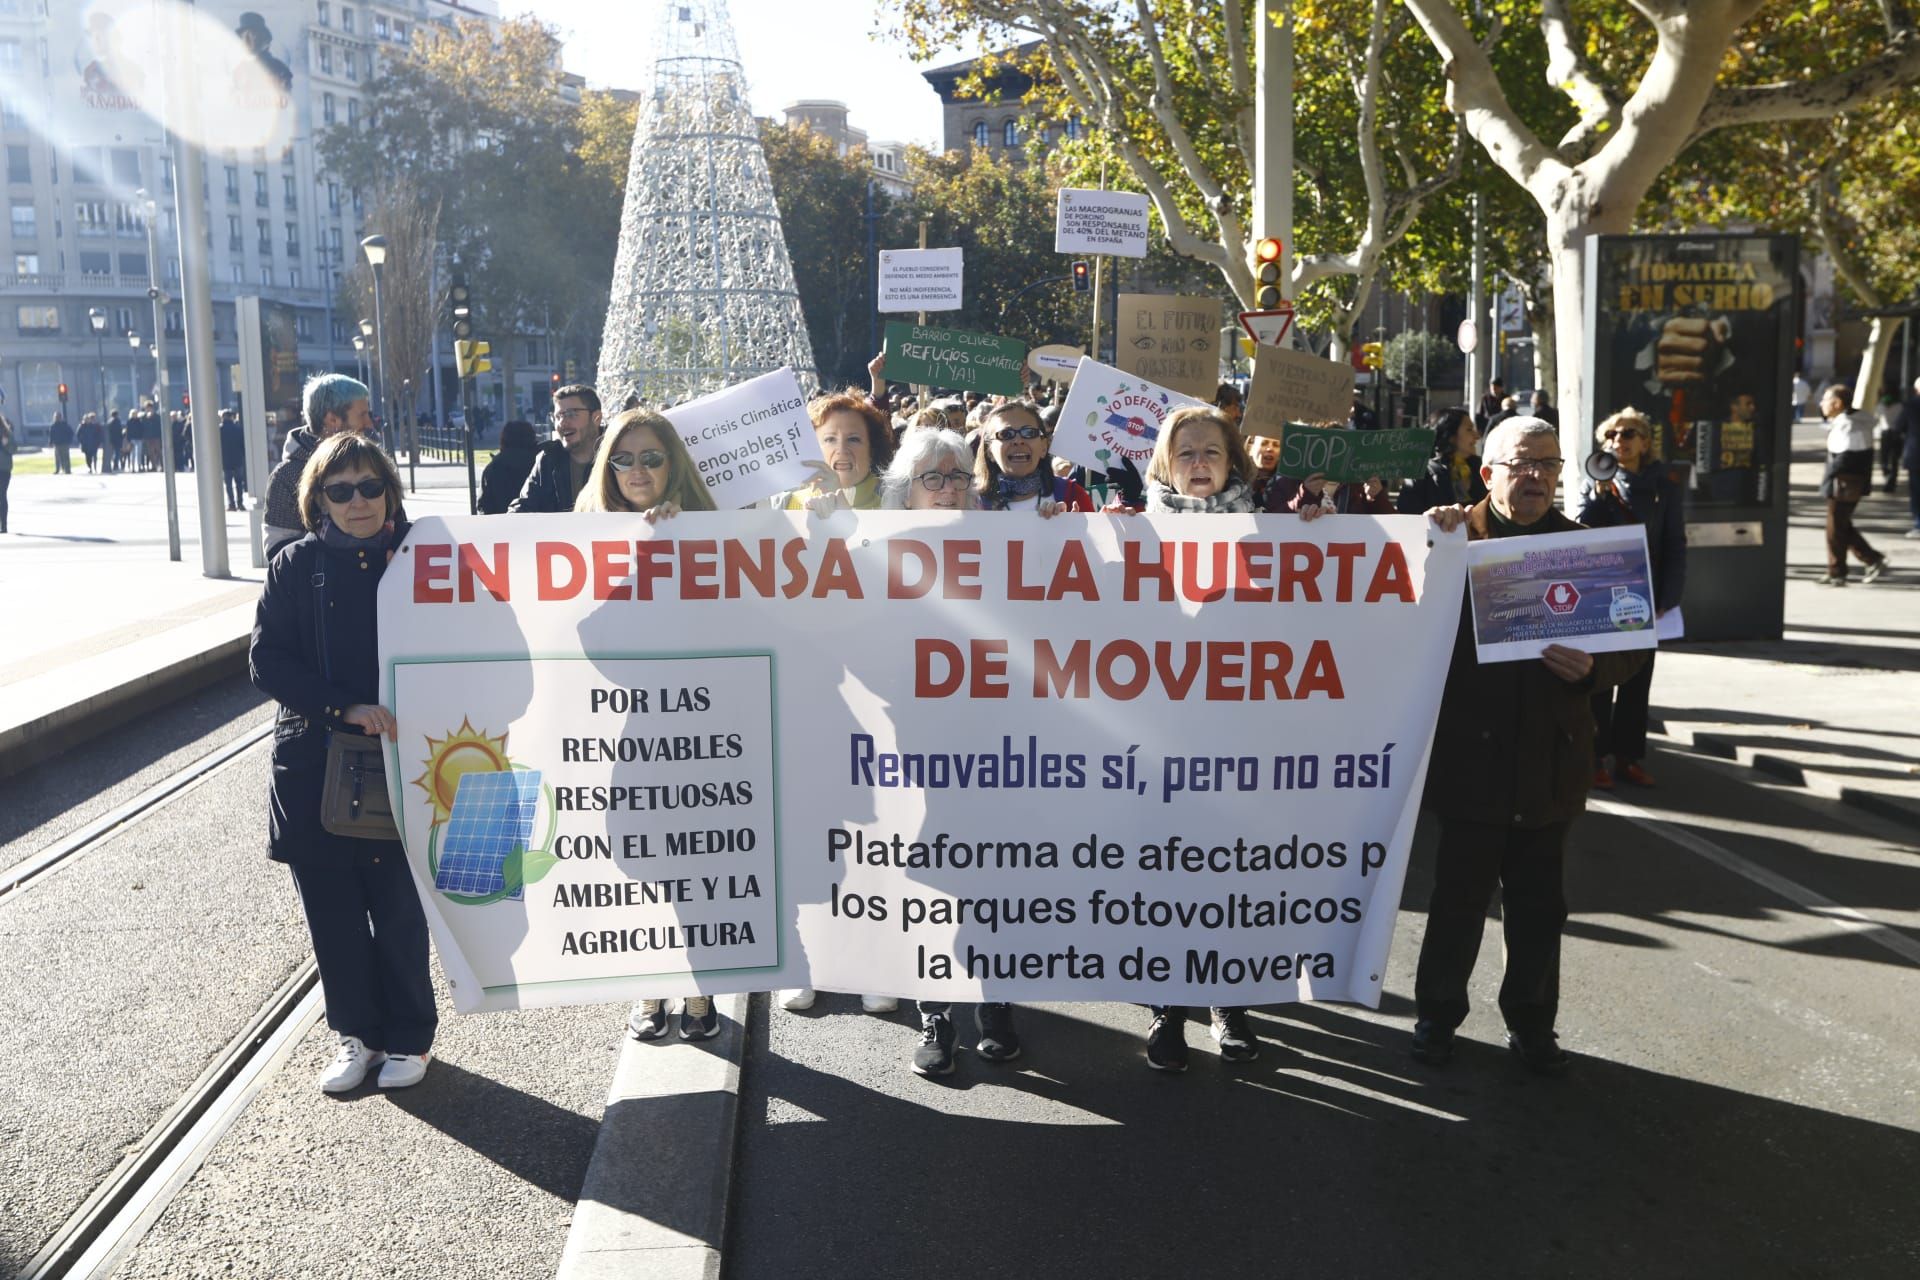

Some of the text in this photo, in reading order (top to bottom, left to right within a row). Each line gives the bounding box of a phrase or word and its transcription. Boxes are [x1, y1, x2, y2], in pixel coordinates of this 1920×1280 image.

[1079, 206, 1142, 216] MACROGRANJAS
[1082, 220, 1140, 230] RESPONSABLES
[1095, 228, 1108, 236] DEL
[1112, 229, 1145, 238] METANO
[1098, 236, 1122, 244] ESPAÑA
[1620, 283, 1774, 310] EN SERIO
[1136, 310, 1156, 330] EL
[912, 327, 1000, 349] BARRIO OLIVER
[948, 364, 976, 384] YA!!
[1105, 396, 1166, 424] YO DEFIEN
[684, 434, 698, 448] te
[702, 420, 738, 440] Crisis
[1102, 431, 1114, 445] LA
[1127, 421, 1144, 432] STOP
[698, 422, 800, 473] enovables sí
[706, 441, 800, 487] ero no así !
[414, 538, 1417, 604] EN DEFENSA DE LA HUERTA
[1553, 604, 1573, 612] STOP
[914, 638, 1345, 701] DE MOVERA
[590, 686, 711, 714] POR LAS
[562, 734, 743, 762] RENOVABLES
[850, 732, 1397, 803] Renovables sí, pero no así
[555, 780, 753, 811] RESPETUOSAS
[554, 828, 756, 860] CON EL MEDIO
[828, 828, 1058, 870] Plataforma
[1072, 834, 1126, 870] de
[1138, 834, 1348, 874] afectados
[552, 874, 761, 908] AMBIENTE Y LA
[831, 883, 1362, 934] los parques fotovoltaicos
[561, 920, 756, 956] AGRICULTURA
[917, 944, 1336, 984] la huerta de Movera
